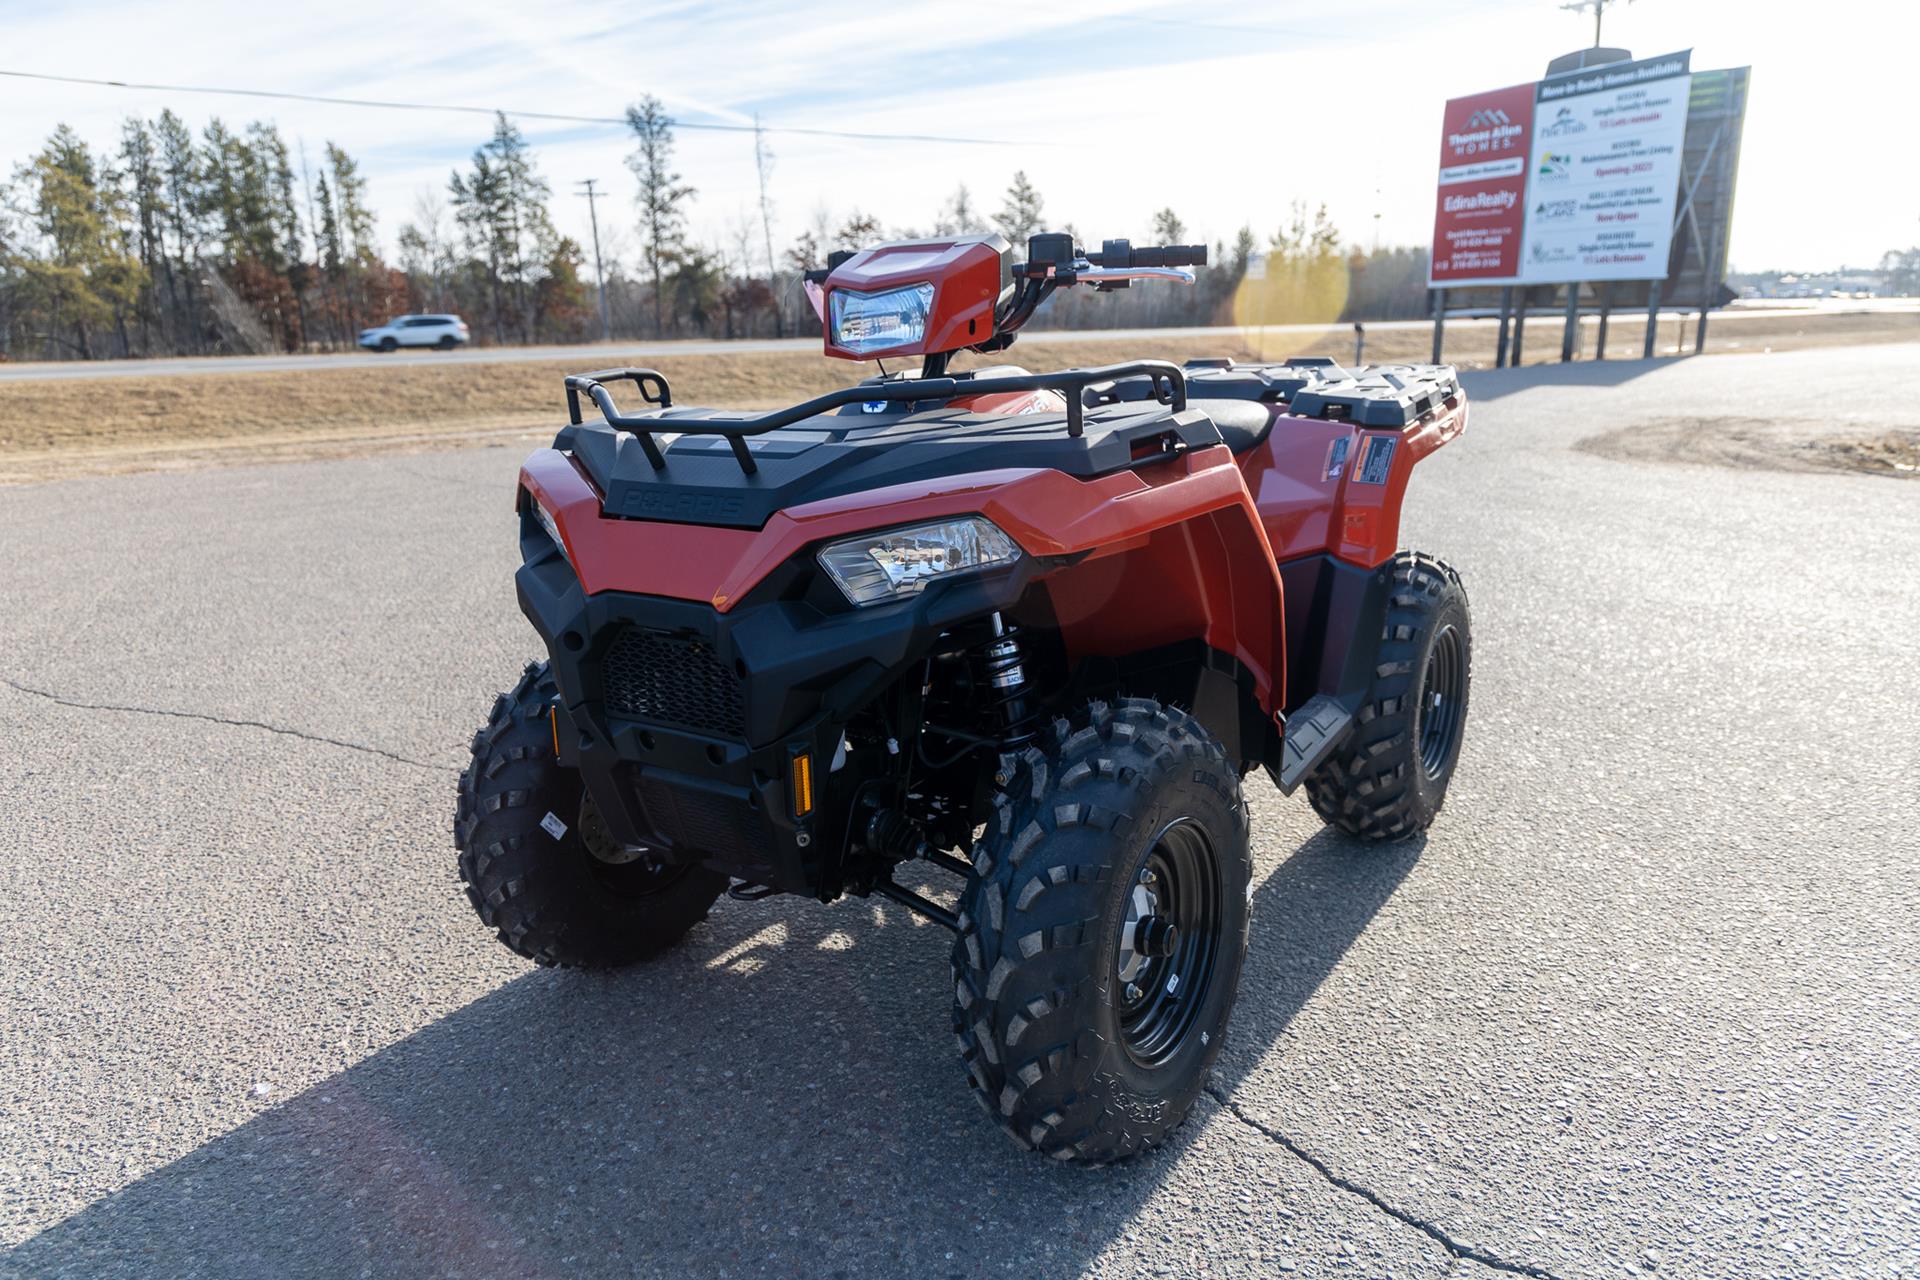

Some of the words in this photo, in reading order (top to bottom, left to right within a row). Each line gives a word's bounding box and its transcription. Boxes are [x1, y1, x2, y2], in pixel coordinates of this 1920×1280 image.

[1637, 61, 1683, 79] Available
[1449, 130, 1491, 147] Thomas
[1492, 124, 1523, 138] Allen
[1595, 165, 1630, 178] Opening
[1616, 212, 1639, 223] Open
[622, 486, 745, 517] POLARIS
